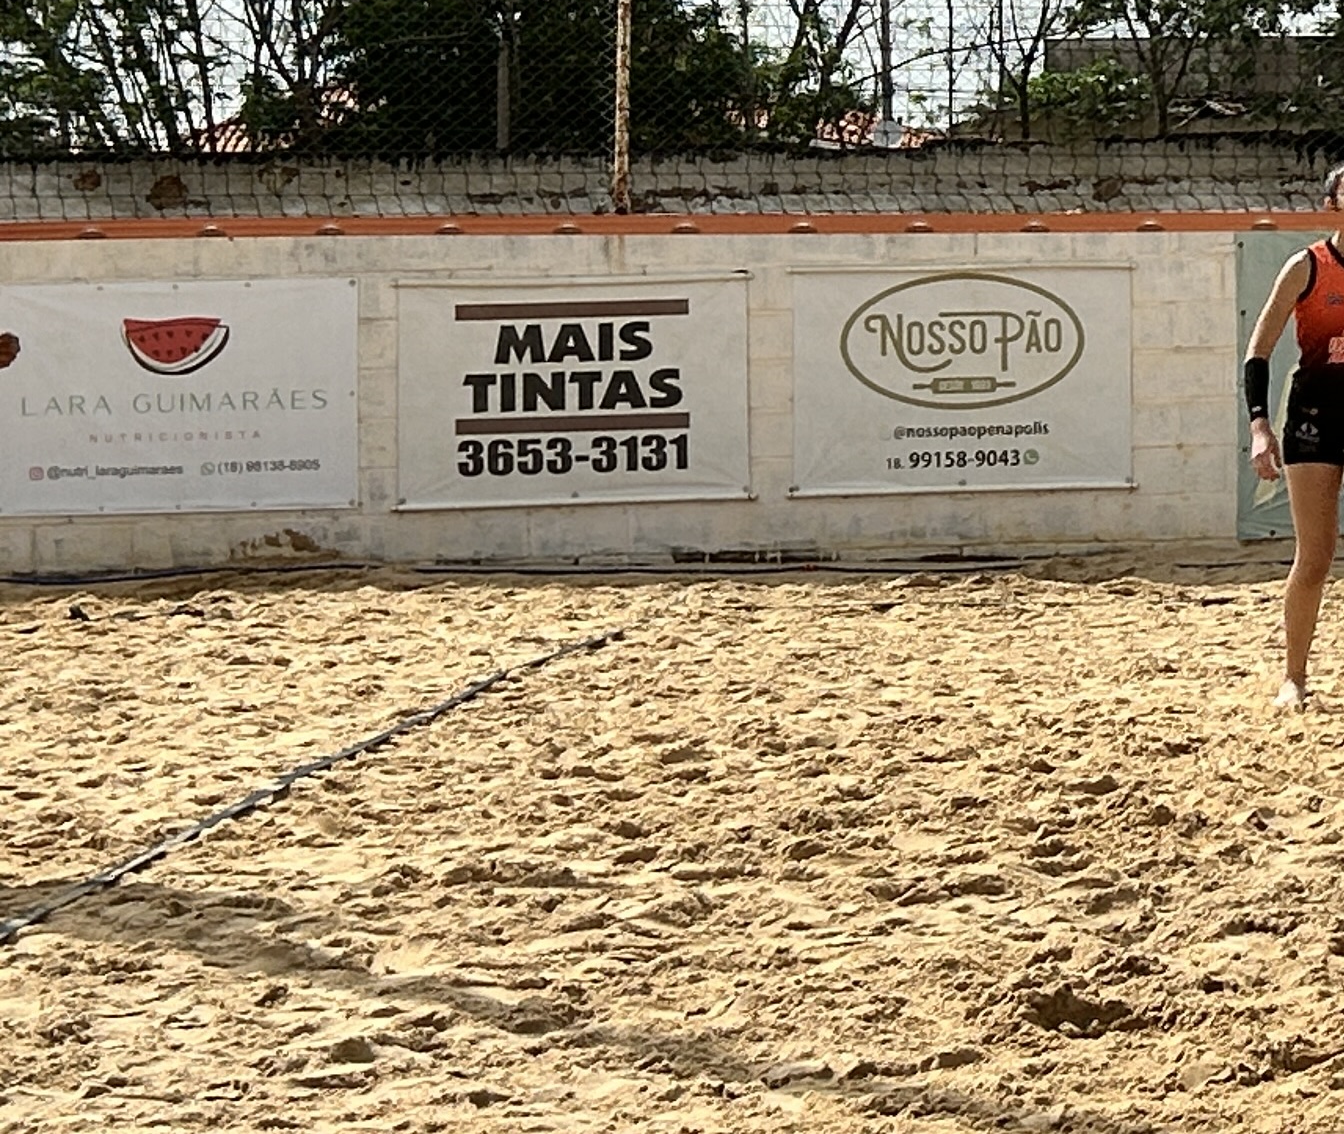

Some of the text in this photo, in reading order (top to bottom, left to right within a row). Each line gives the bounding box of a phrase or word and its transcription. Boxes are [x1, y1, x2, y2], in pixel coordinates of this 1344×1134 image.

[494, 320, 654, 364] MAIS
[864, 309, 1063, 374] NOSSO PÃO
[20, 387, 329, 417] LARA GUIMARÃES
[462, 368, 684, 414] TINTAS
[88, 430, 262, 444] NUTRICIONISTA
[893, 420, 1049, 441] @nossopaopenapolis
[457, 433, 689, 477] 3653-3131
[908, 449, 1021, 468] 99158-9043
